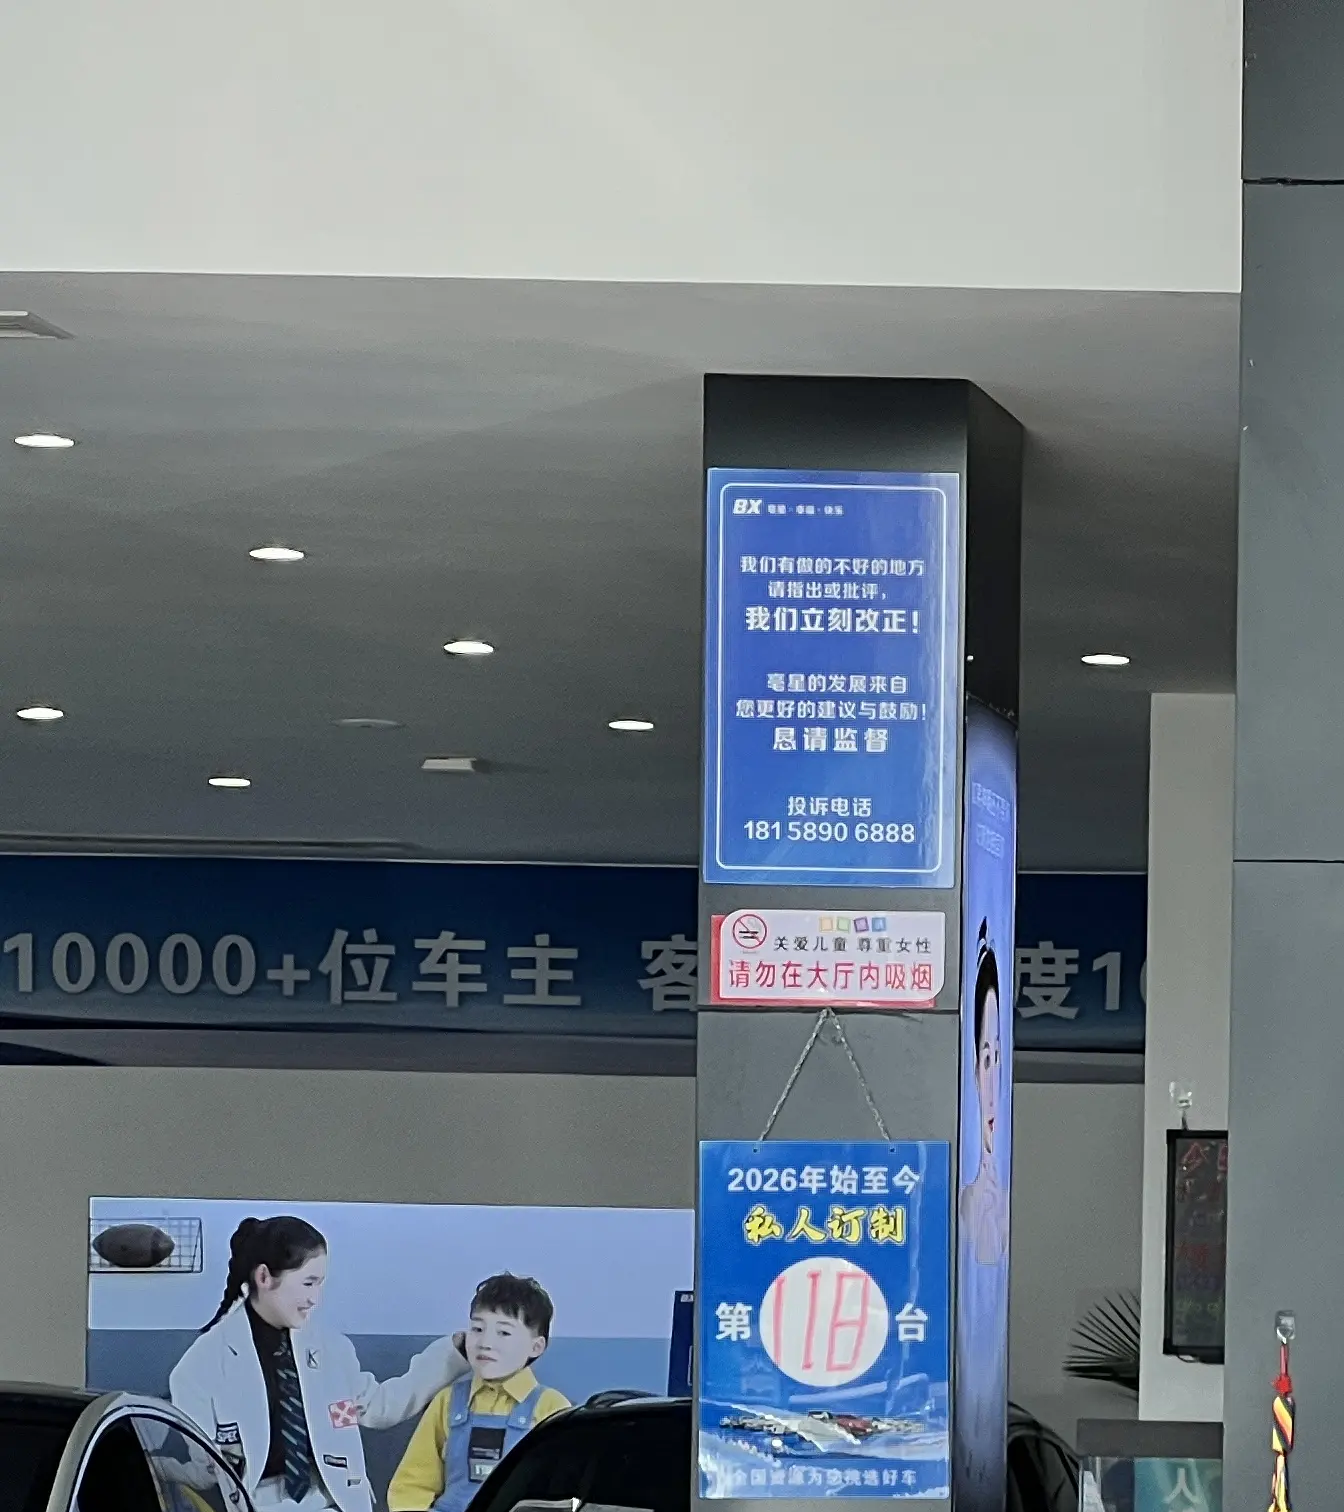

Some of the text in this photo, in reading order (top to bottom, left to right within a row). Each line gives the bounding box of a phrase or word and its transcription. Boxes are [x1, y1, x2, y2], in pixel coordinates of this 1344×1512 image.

[740, 555, 925, 577] 我们有做的不好的地方
[773, 726, 889, 753] 恳请监督
[787, 796, 872, 818] 投诉电话
[743, 820, 915, 843] 181 5890 6888
[774, 935, 932, 954] 关爱儿童 尊重女性
[3, 928, 582, 1012] 10000+位车主
[1015, 940, 1146, 1020] 度1
[728, 959, 933, 991] 请勿在大厅内吸烟
[728, 1165, 920, 1196] 2026年始至今
[743, 1206, 905, 1246] 私人订制
[715, 1301, 753, 1342] 第
[895, 1302, 928, 1342] 台
